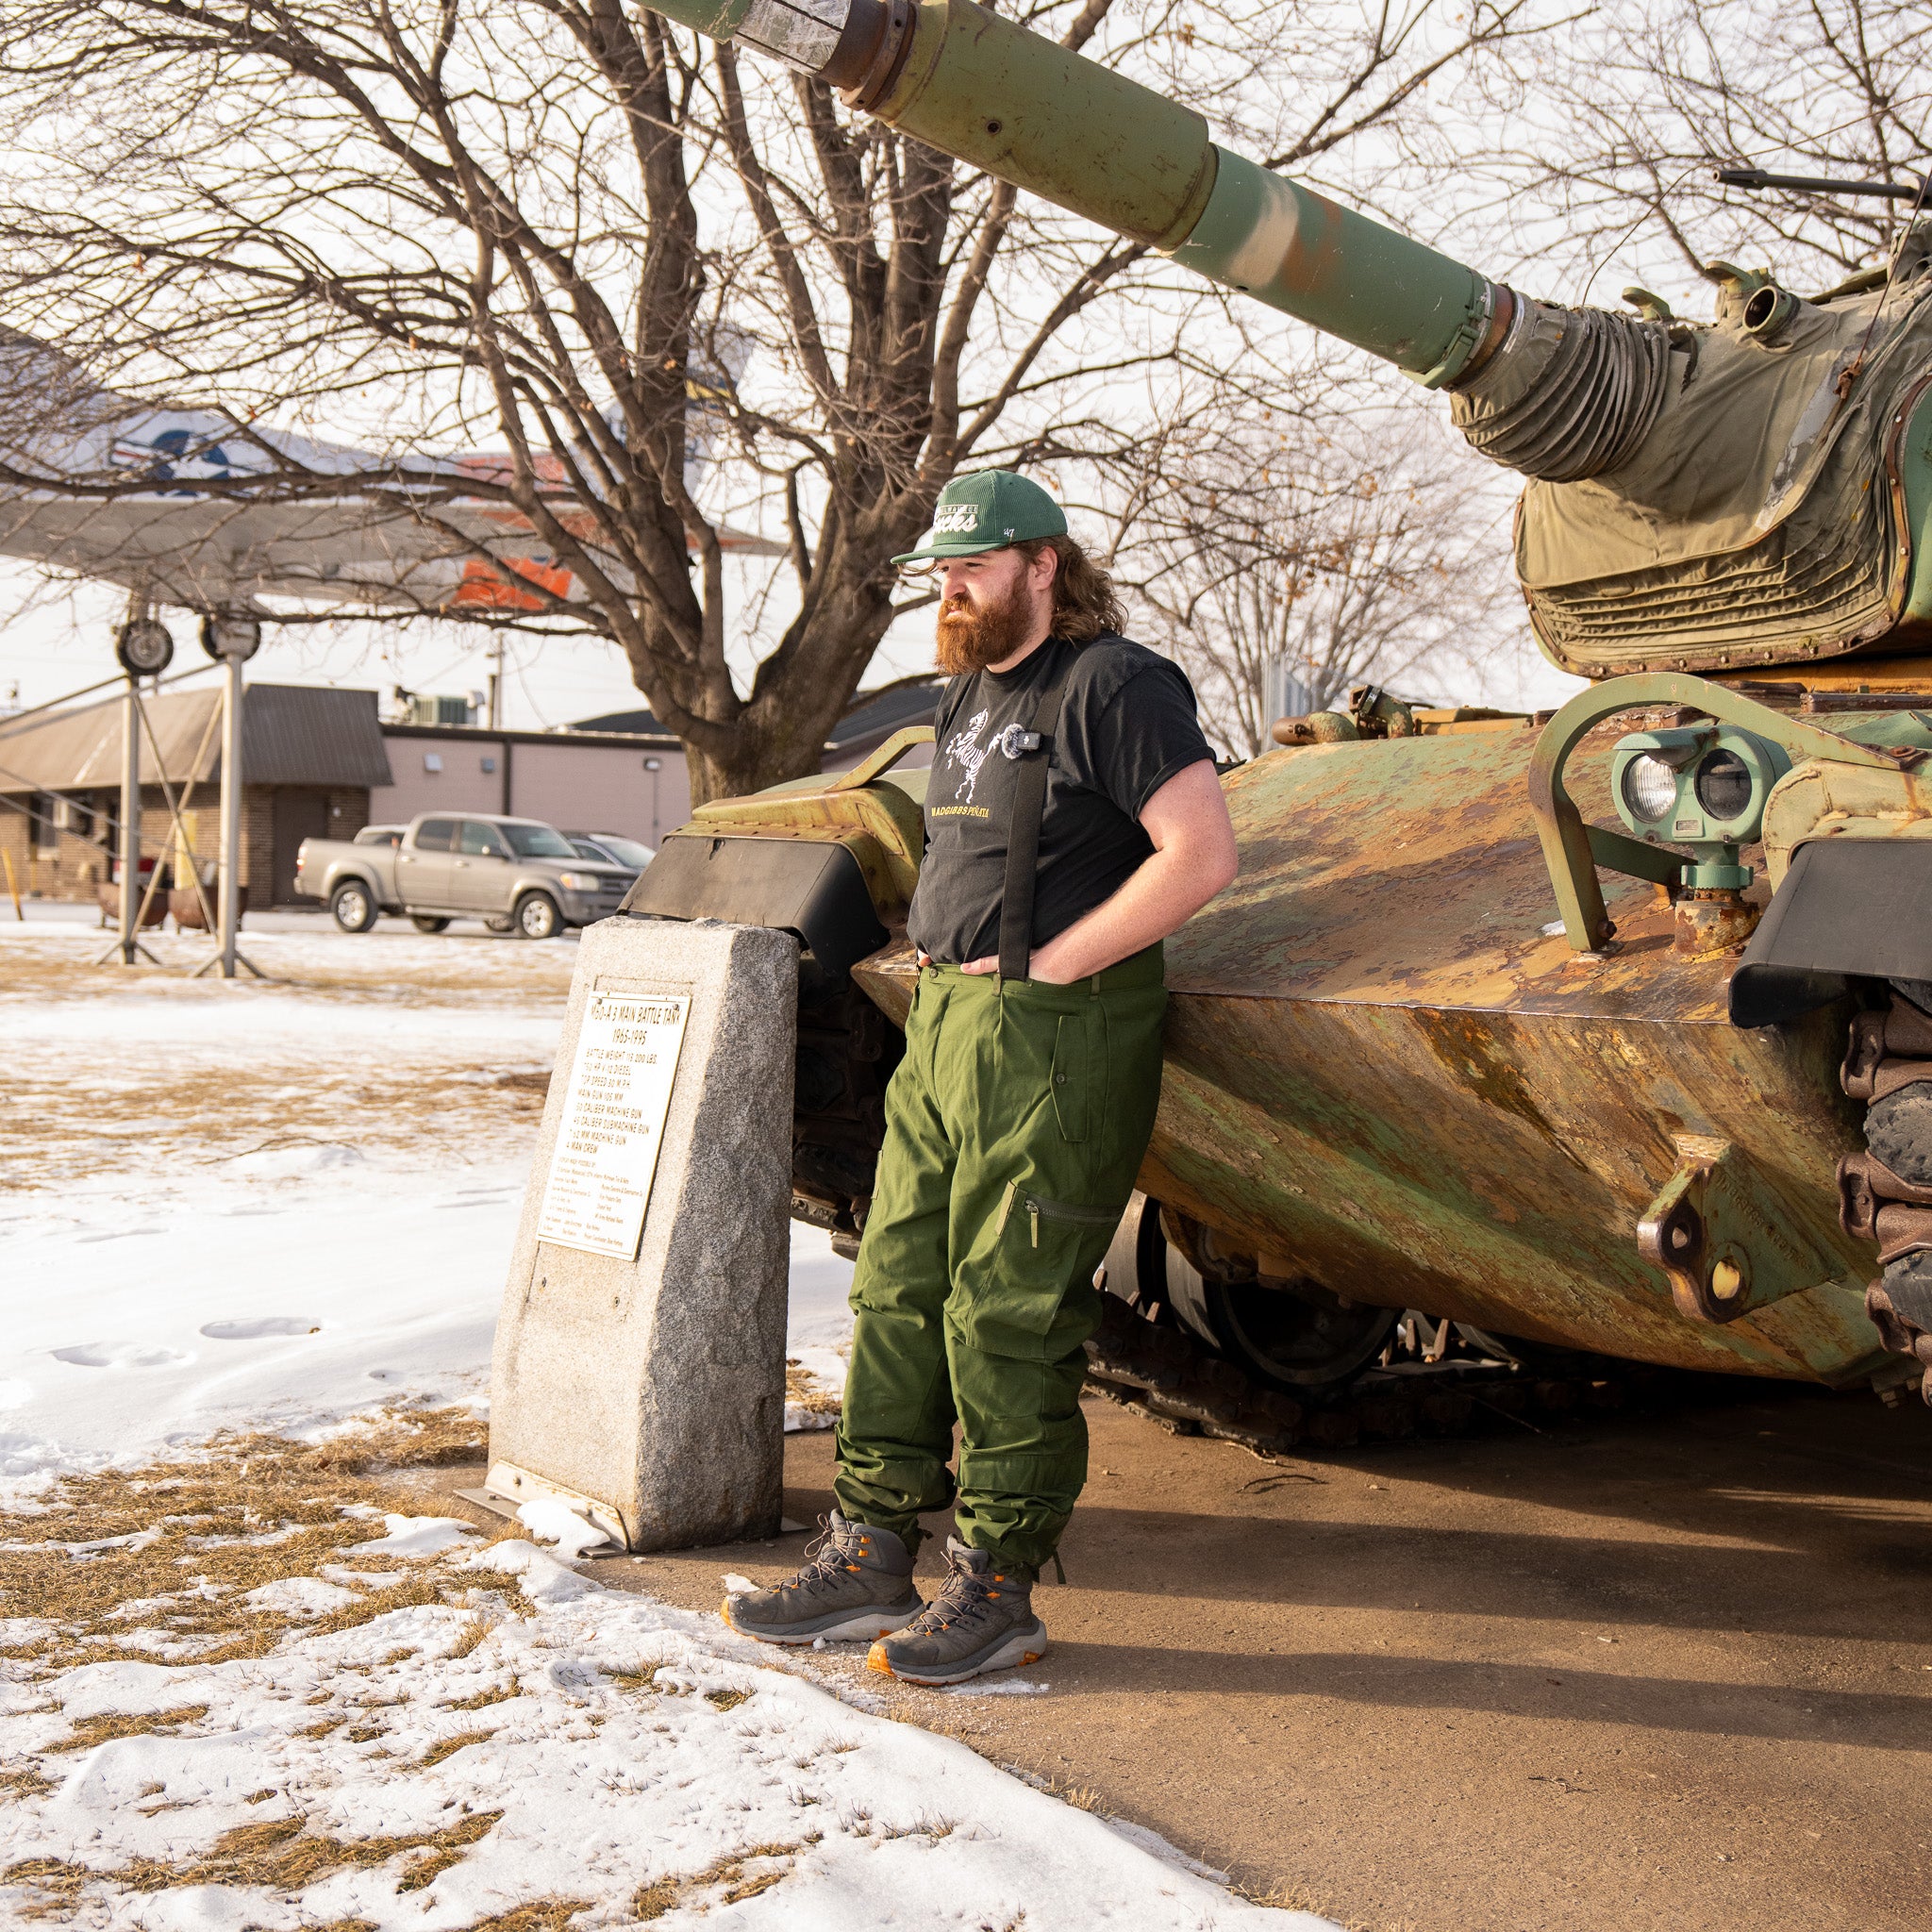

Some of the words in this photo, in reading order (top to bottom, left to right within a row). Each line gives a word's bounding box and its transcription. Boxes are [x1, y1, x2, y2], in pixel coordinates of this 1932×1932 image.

[618, 1006, 636, 1023] MAIN
[637, 1007, 662, 1024] BATTLE
[662, 1008, 682, 1026] TANK
[612, 1028, 647, 1045] 1965-1995
[586, 1048, 604, 1059] BATTLE
[605, 1050, 625, 1060] WEIGHT
[612, 1065, 631, 1076] DIESEL
[581, 1074, 591, 1085] TOP
[591, 1075, 607, 1087] SPEED
[577, 1089, 591, 1098] MAIN
[591, 1090, 603, 1100] GUN
[613, 1092, 624, 1102] MM
[583, 1103, 606, 1114] CALIBER
[606, 1106, 630, 1118] MACHINE
[629, 1108, 642, 1120] GUN
[580, 1116, 603, 1127] CALIBER
[603, 1119, 638, 1133] SUBMACHINE
[637, 1124, 650, 1135] GUN
[580, 1130, 591, 1140] MM
[590, 1131, 615, 1144] MACHINE
[614, 1135, 627, 1146] GUN
[571, 1141, 583, 1152] MAN
[583, 1142, 599, 1155] CREW
